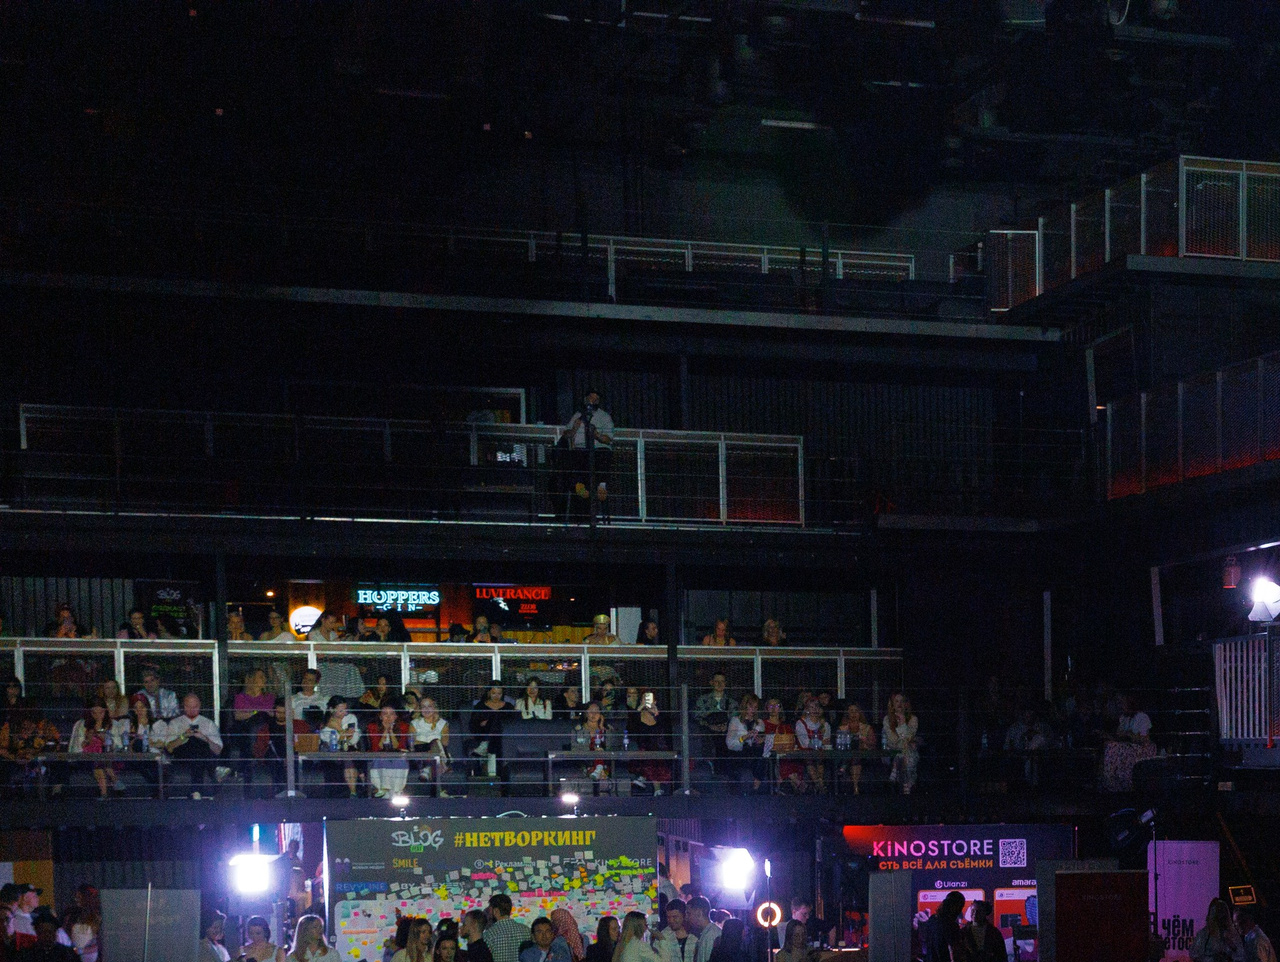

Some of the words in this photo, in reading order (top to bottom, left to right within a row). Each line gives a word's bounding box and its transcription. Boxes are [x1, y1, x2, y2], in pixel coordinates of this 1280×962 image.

[357, 589, 440, 605] HOPPERS
[476, 587, 549, 600] LUVERANCE
[391, 826, 445, 850] BLOG
[454, 830, 597, 848] #НЕТВОРКИНГ
[392, 858, 418, 869] SMILE
[878, 860, 900, 870] СТЬ
[903, 858, 923, 870] ВСЁ
[925, 859, 947, 870] ДЛЯ
[949, 858, 994, 869] СЪЁМКИ
[335, 882, 386, 893] REVYLINE
[1012, 879, 1037, 887] amara
[1161, 915, 1194, 937] чём
